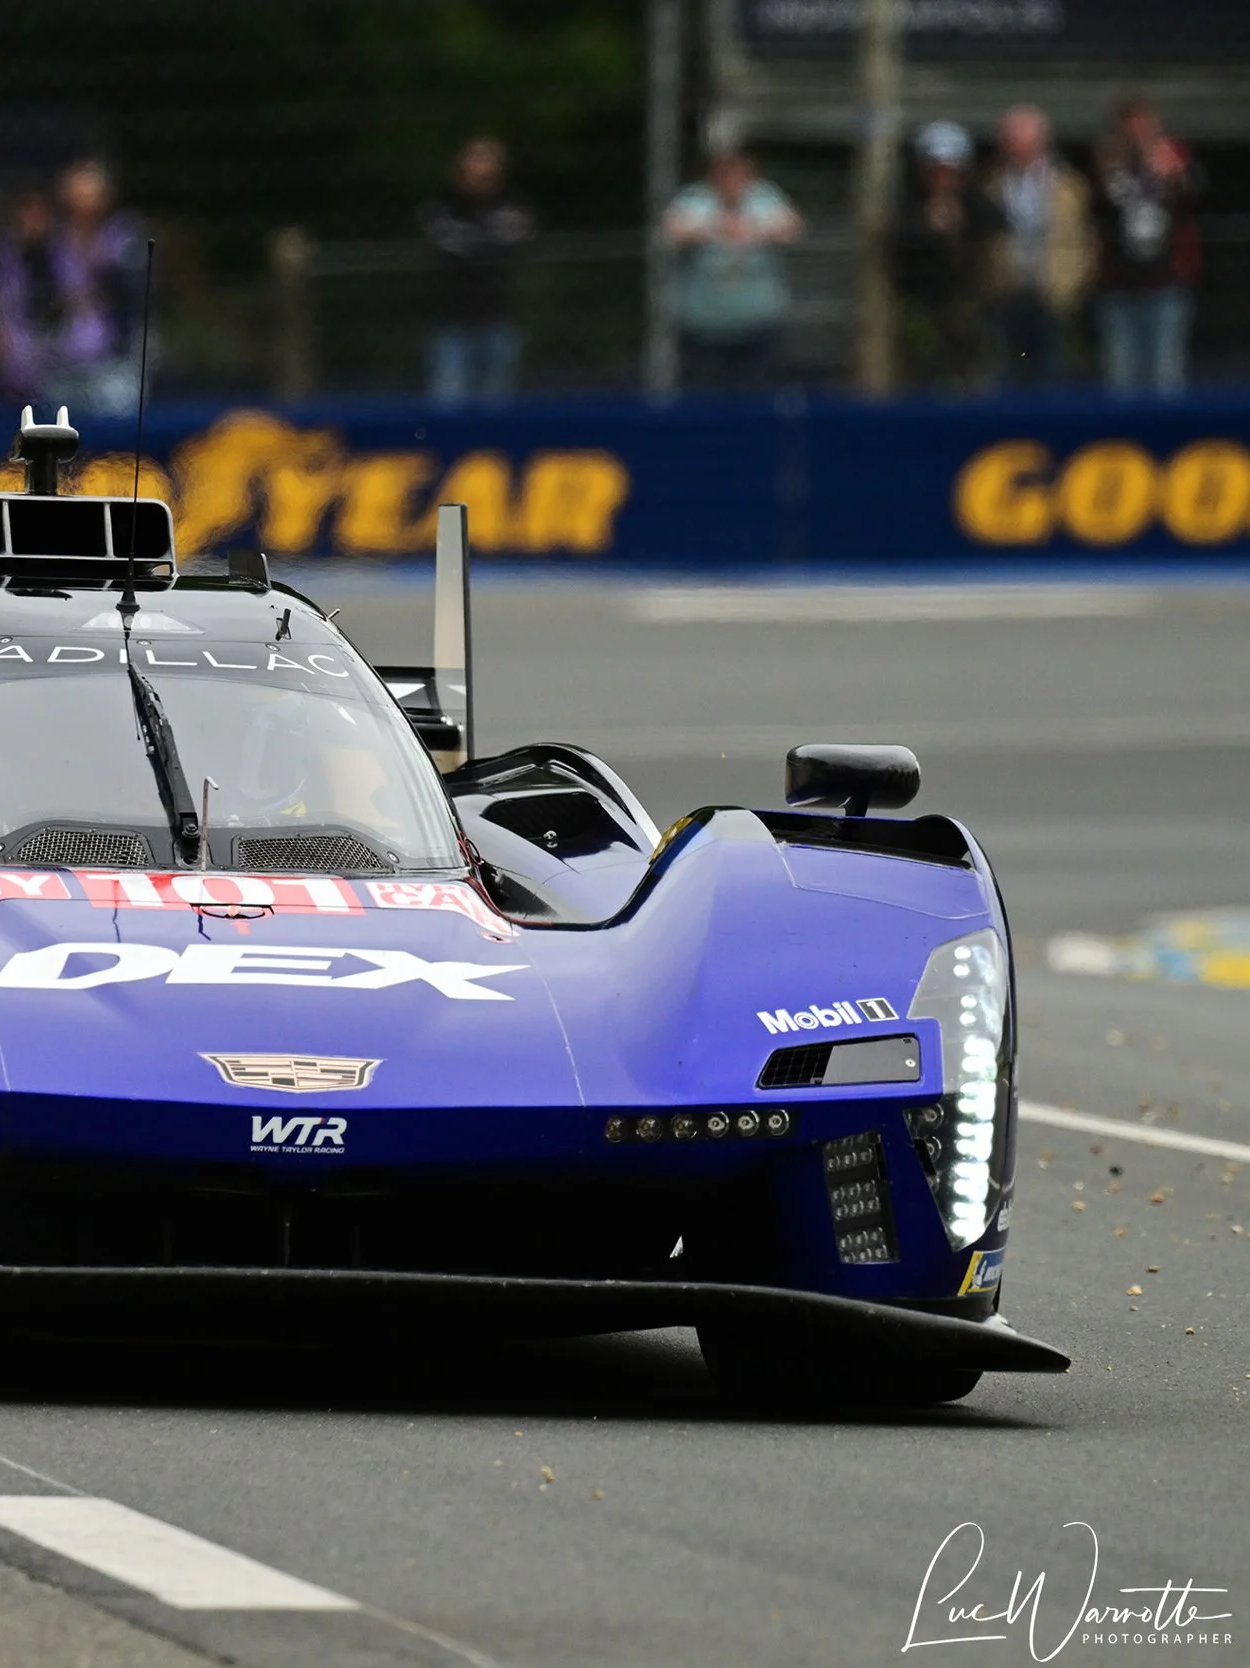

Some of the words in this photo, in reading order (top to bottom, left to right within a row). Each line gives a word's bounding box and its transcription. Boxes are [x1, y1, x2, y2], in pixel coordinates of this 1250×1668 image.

[86, 873, 350, 912] 101
[756, 1000, 862, 1035] Mobil
[252, 1116, 347, 1146] WTR
